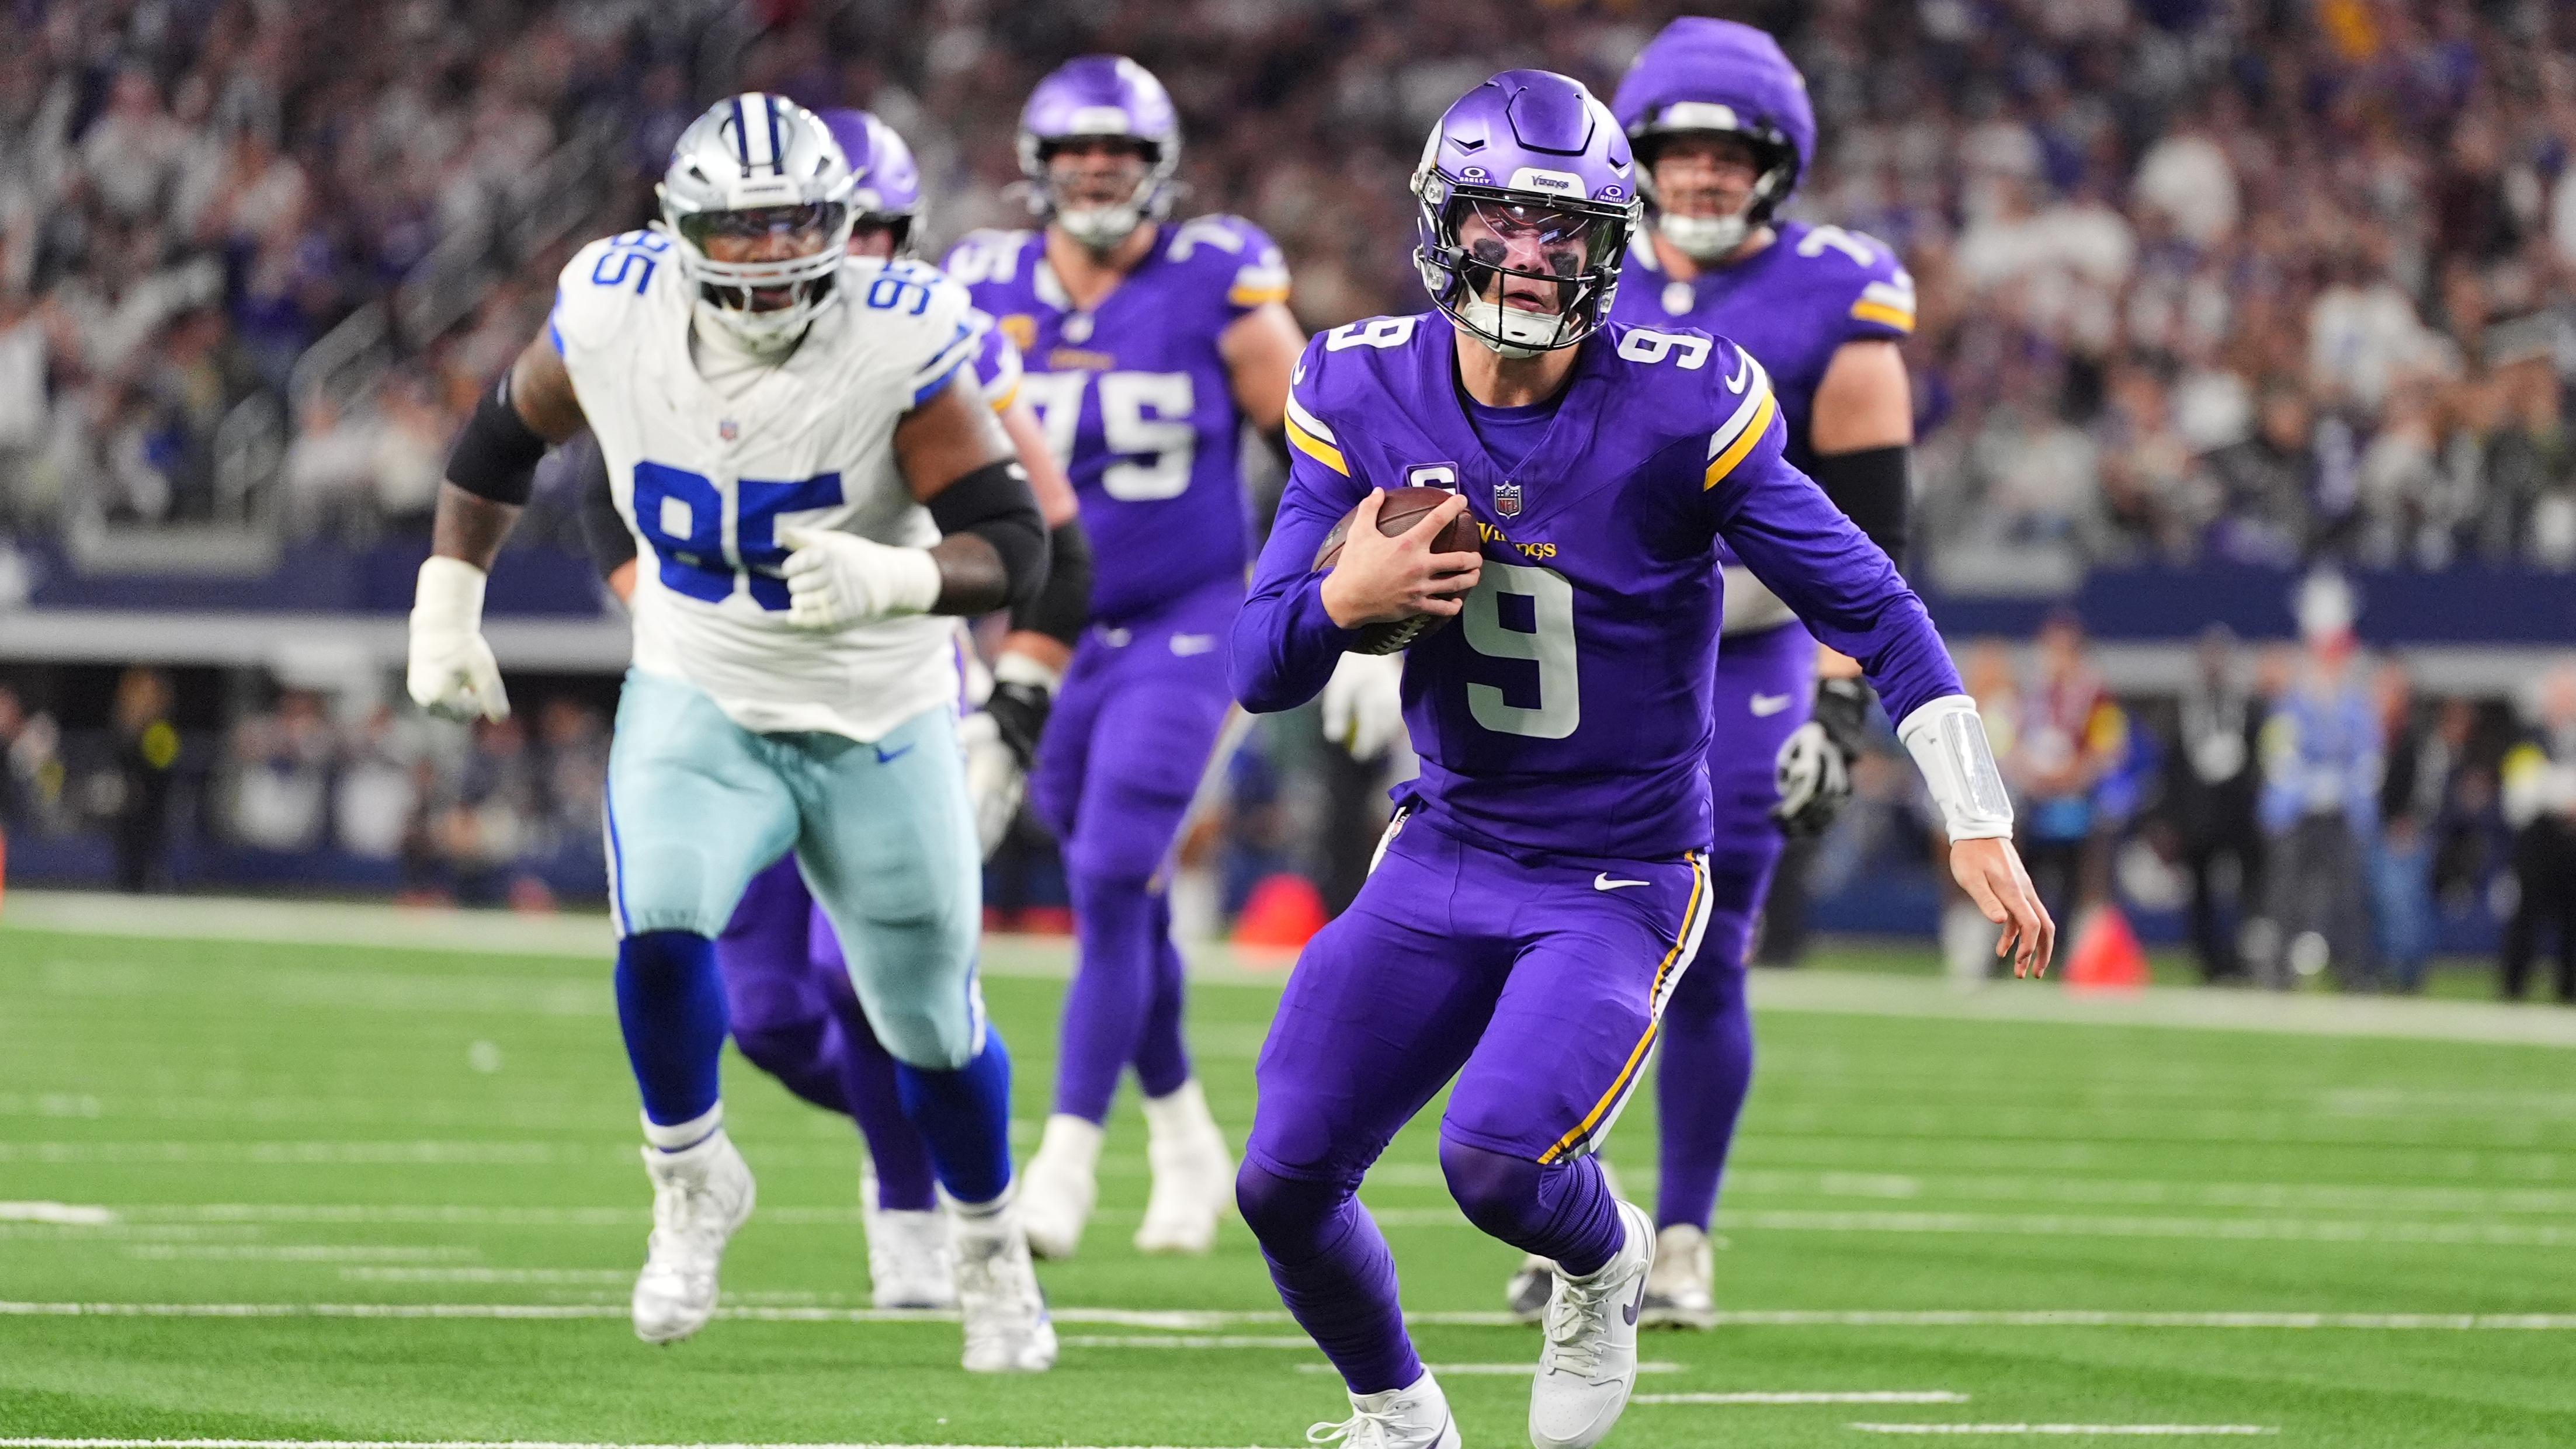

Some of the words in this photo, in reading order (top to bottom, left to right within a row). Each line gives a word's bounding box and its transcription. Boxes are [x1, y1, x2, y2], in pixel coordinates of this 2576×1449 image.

[1600, 194, 1623, 203] OAKLEY
[1326, 317, 1416, 352] 9
[1617, 328, 1713, 370] 9
[1476, 521, 1557, 561] Vings
[1462, 560, 1581, 740] 9
